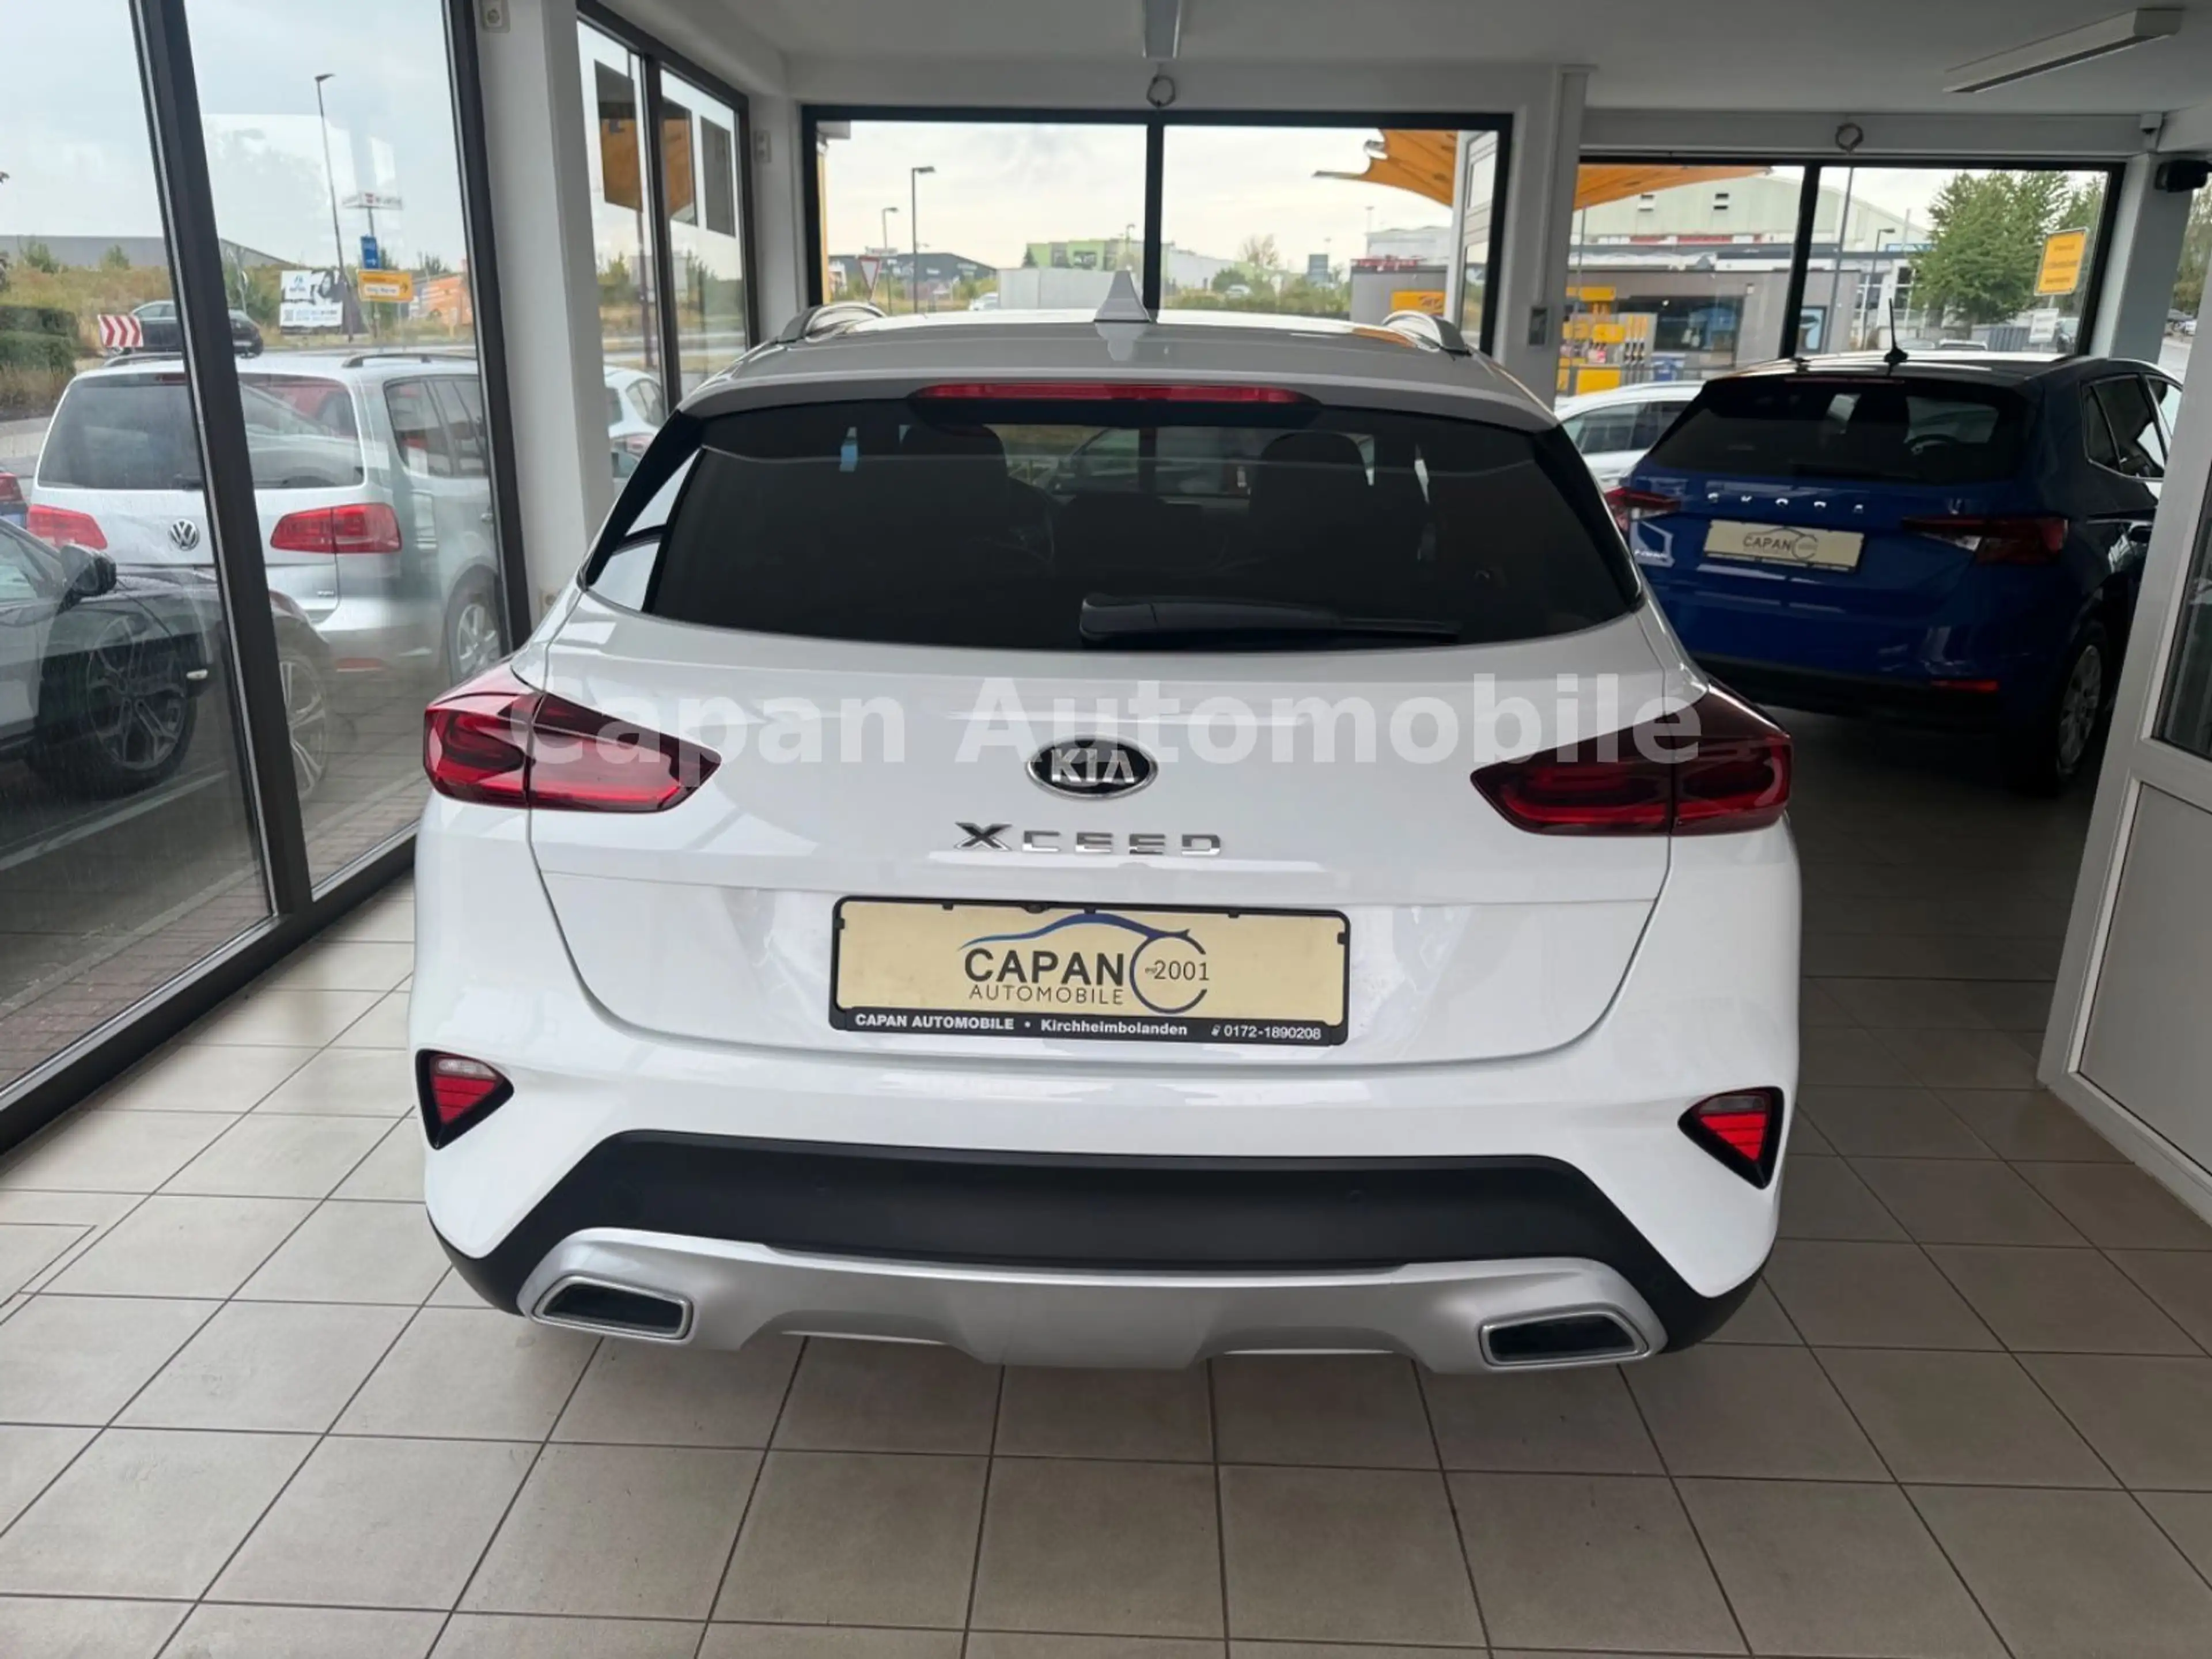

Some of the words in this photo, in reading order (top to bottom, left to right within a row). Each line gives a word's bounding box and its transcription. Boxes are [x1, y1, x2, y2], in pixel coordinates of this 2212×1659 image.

[1743, 533, 1792, 551] CAPAN
[1051, 748, 1135, 783] KIA
[953, 821, 1221, 856] XCEED
[964, 948, 1125, 987] CAPAN
[1154, 959, 1210, 981] 2001
[968, 984, 1125, 1005] AUTOMOBILE
[855, 1013, 908, 1028] CAPAN
[911, 1015, 1015, 1030] AUTOMOBILE
[1040, 1018, 1188, 1036] Kirchheimbolanden
[1224, 1027, 1322, 1040] 0172-1890208
